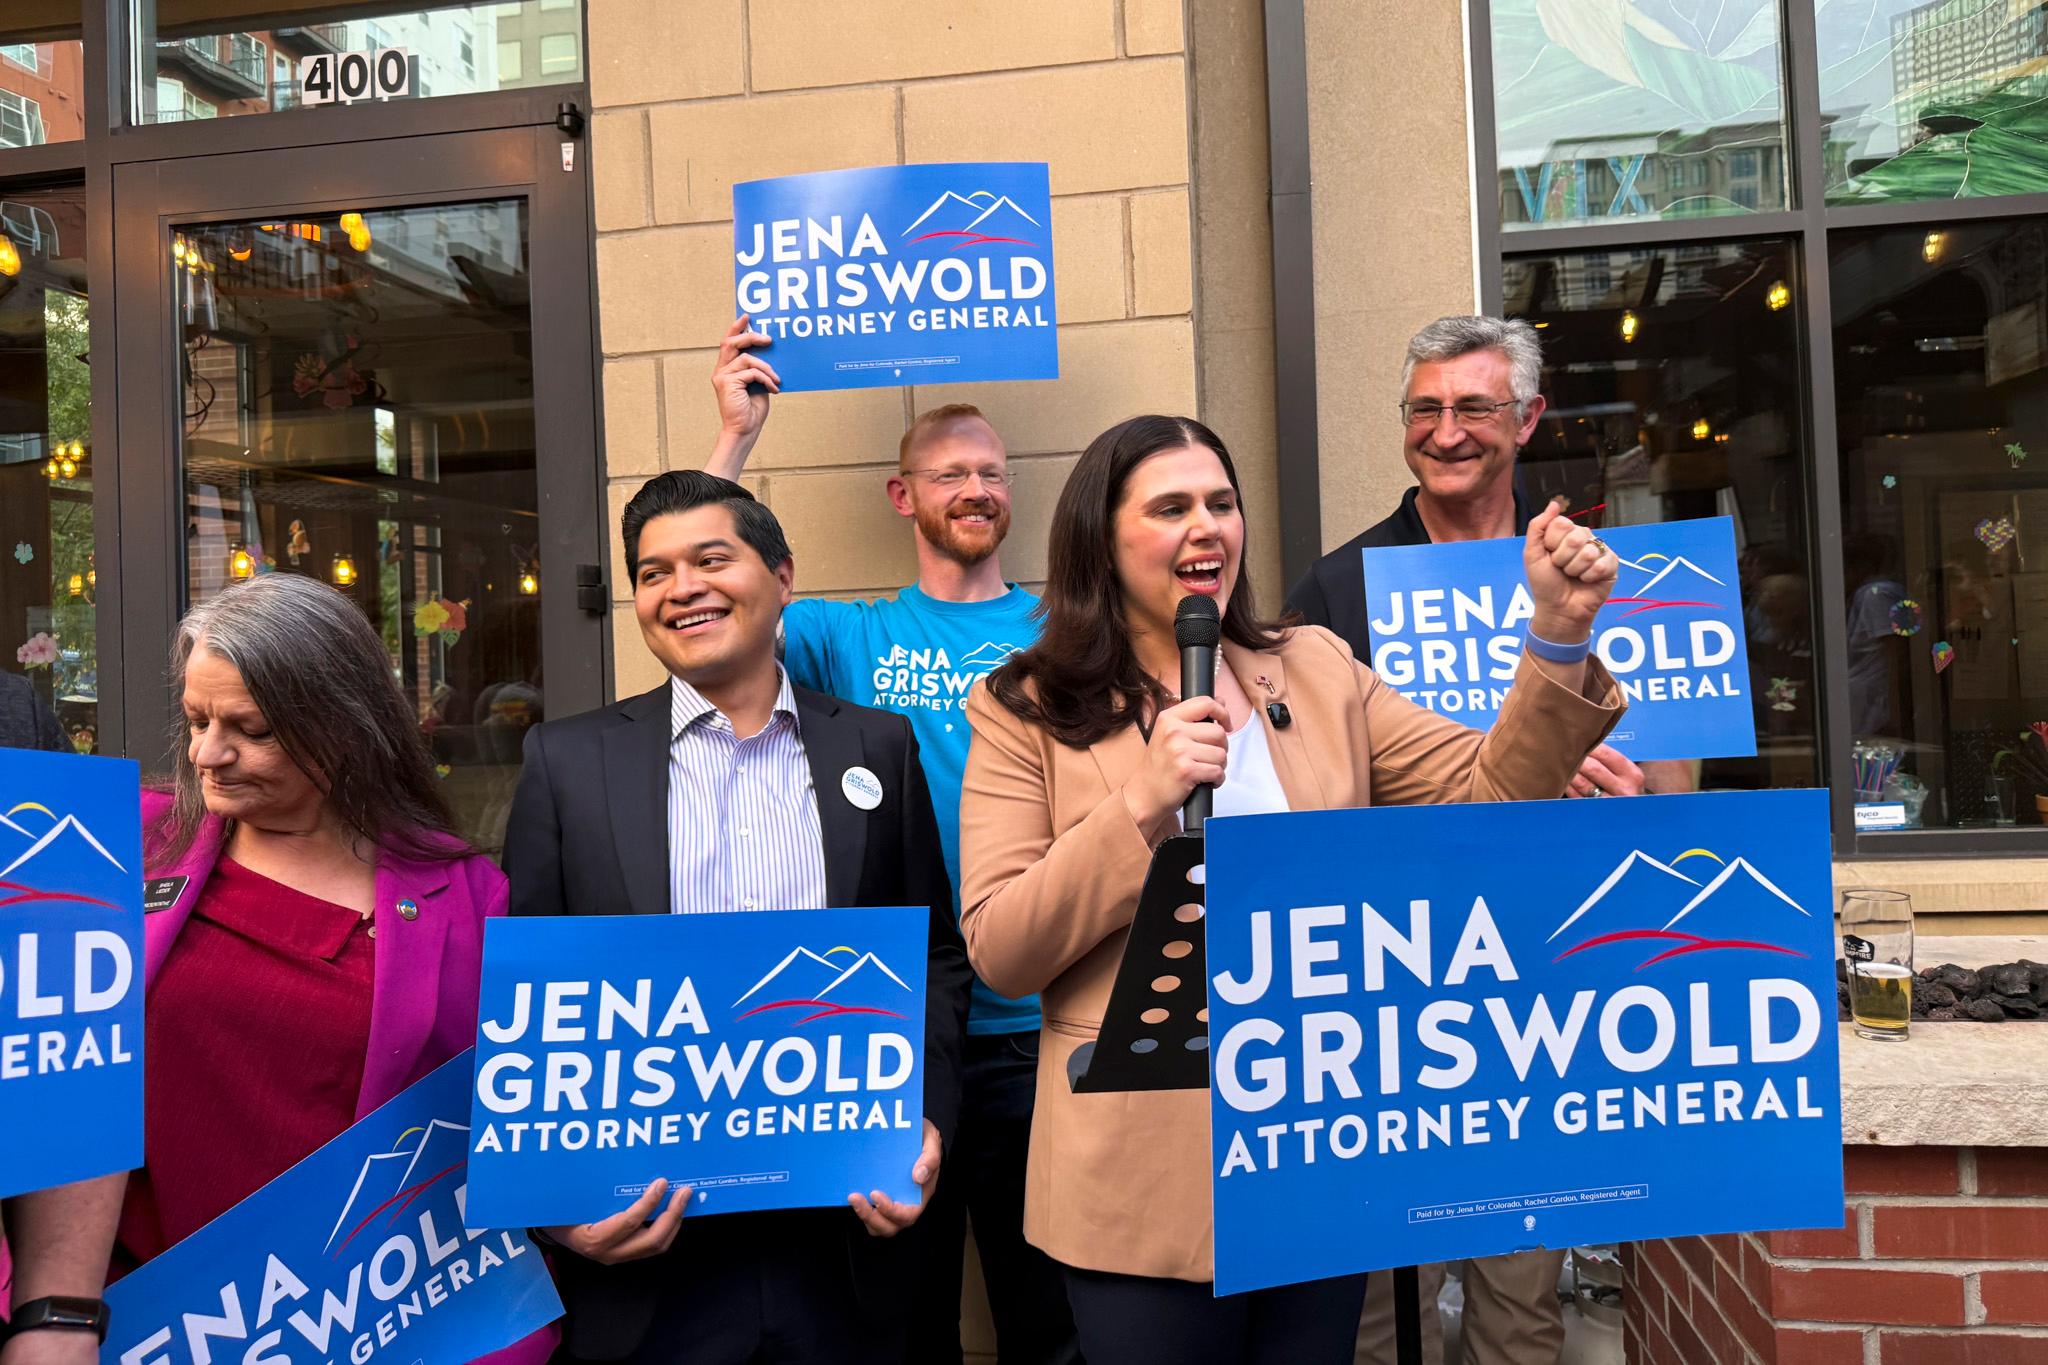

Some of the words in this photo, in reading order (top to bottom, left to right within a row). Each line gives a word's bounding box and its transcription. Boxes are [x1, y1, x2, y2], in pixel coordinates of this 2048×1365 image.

[304, 50, 407, 100] 400
[736, 212, 888, 267] JENA
[737, 256, 1048, 314] GRISWOLD
[746, 310, 897, 339] TTORNEY
[908, 305, 1049, 331] GENERAL
[1371, 582, 1536, 636] JENA
[877, 643, 951, 672] JENA
[1374, 620, 1736, 686] GRISOLD
[873, 692, 953, 711] ATTORNEY
[1621, 673, 1741, 704] NERAL
[1857, 811, 1879, 819] tyco
[0, 930, 133, 1019] LD
[1212, 895, 1520, 1005] JENA
[481, 976, 711, 1043] JENA
[476, 1032, 915, 1113] GRISWOLD
[1215, 976, 1822, 1113] GRISWOLD
[474, 1111, 711, 1153] ATTORNEY
[726, 1099, 912, 1138] GENERAL
[1219, 1095, 1531, 1178] ATTORNEY
[1553, 1075, 1824, 1136] GENERAL
[1416, 1210, 1432, 1219] Paid
[1434, 1208, 1445, 1217] for
[1446, 1207, 1455, 1217] by
[1457, 1206, 1473, 1214] Jena
[1475, 1204, 1486, 1212] for
[1524, 1197, 1548, 1207] Rachel
[1550, 1194, 1578, 1204] Gordon,
[1580, 1189, 1618, 1202] Registered
[1620, 1187, 1641, 1198] Agent
[242, 1180, 490, 1365] SWOL
[350, 1230, 527, 1365] GENERAL
